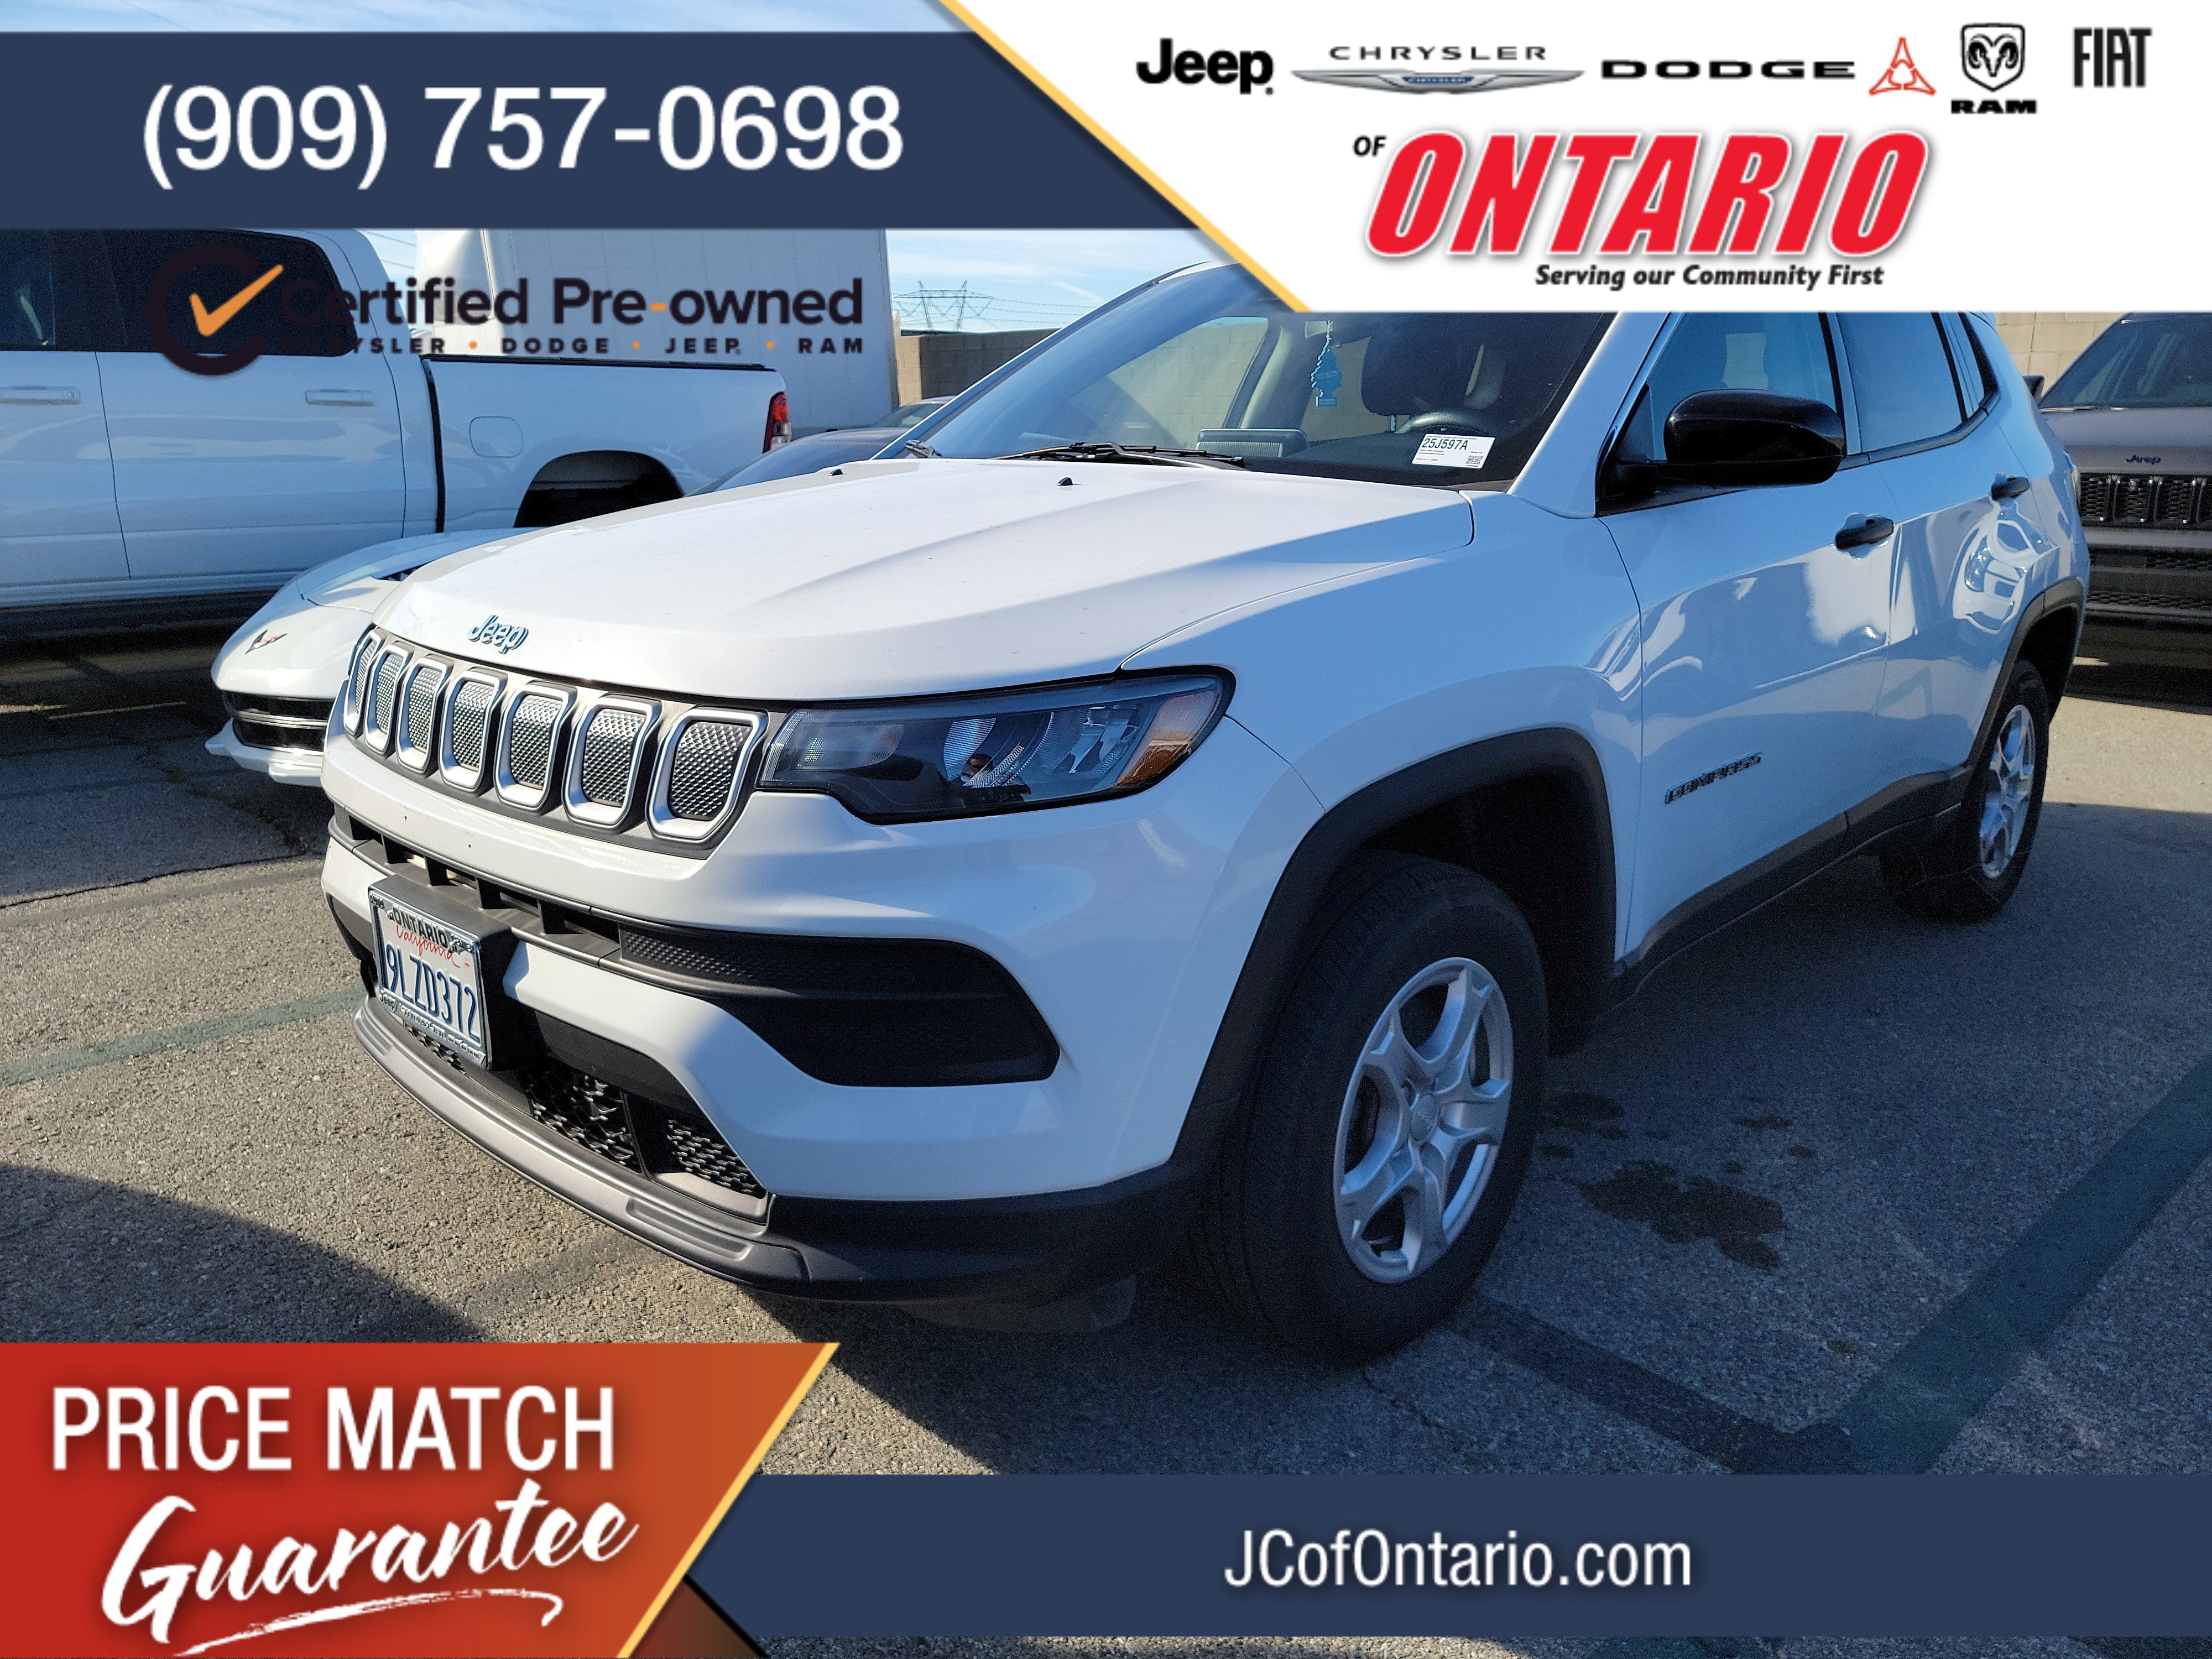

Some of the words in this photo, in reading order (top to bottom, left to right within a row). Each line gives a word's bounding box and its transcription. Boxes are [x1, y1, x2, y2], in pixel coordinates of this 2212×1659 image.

[1421, 437, 1469, 451] 25J597A
[467, 614, 529, 655] Jeep
[393, 905, 450, 949] ONTARIO
[386, 943, 481, 1042] 9LZD372
